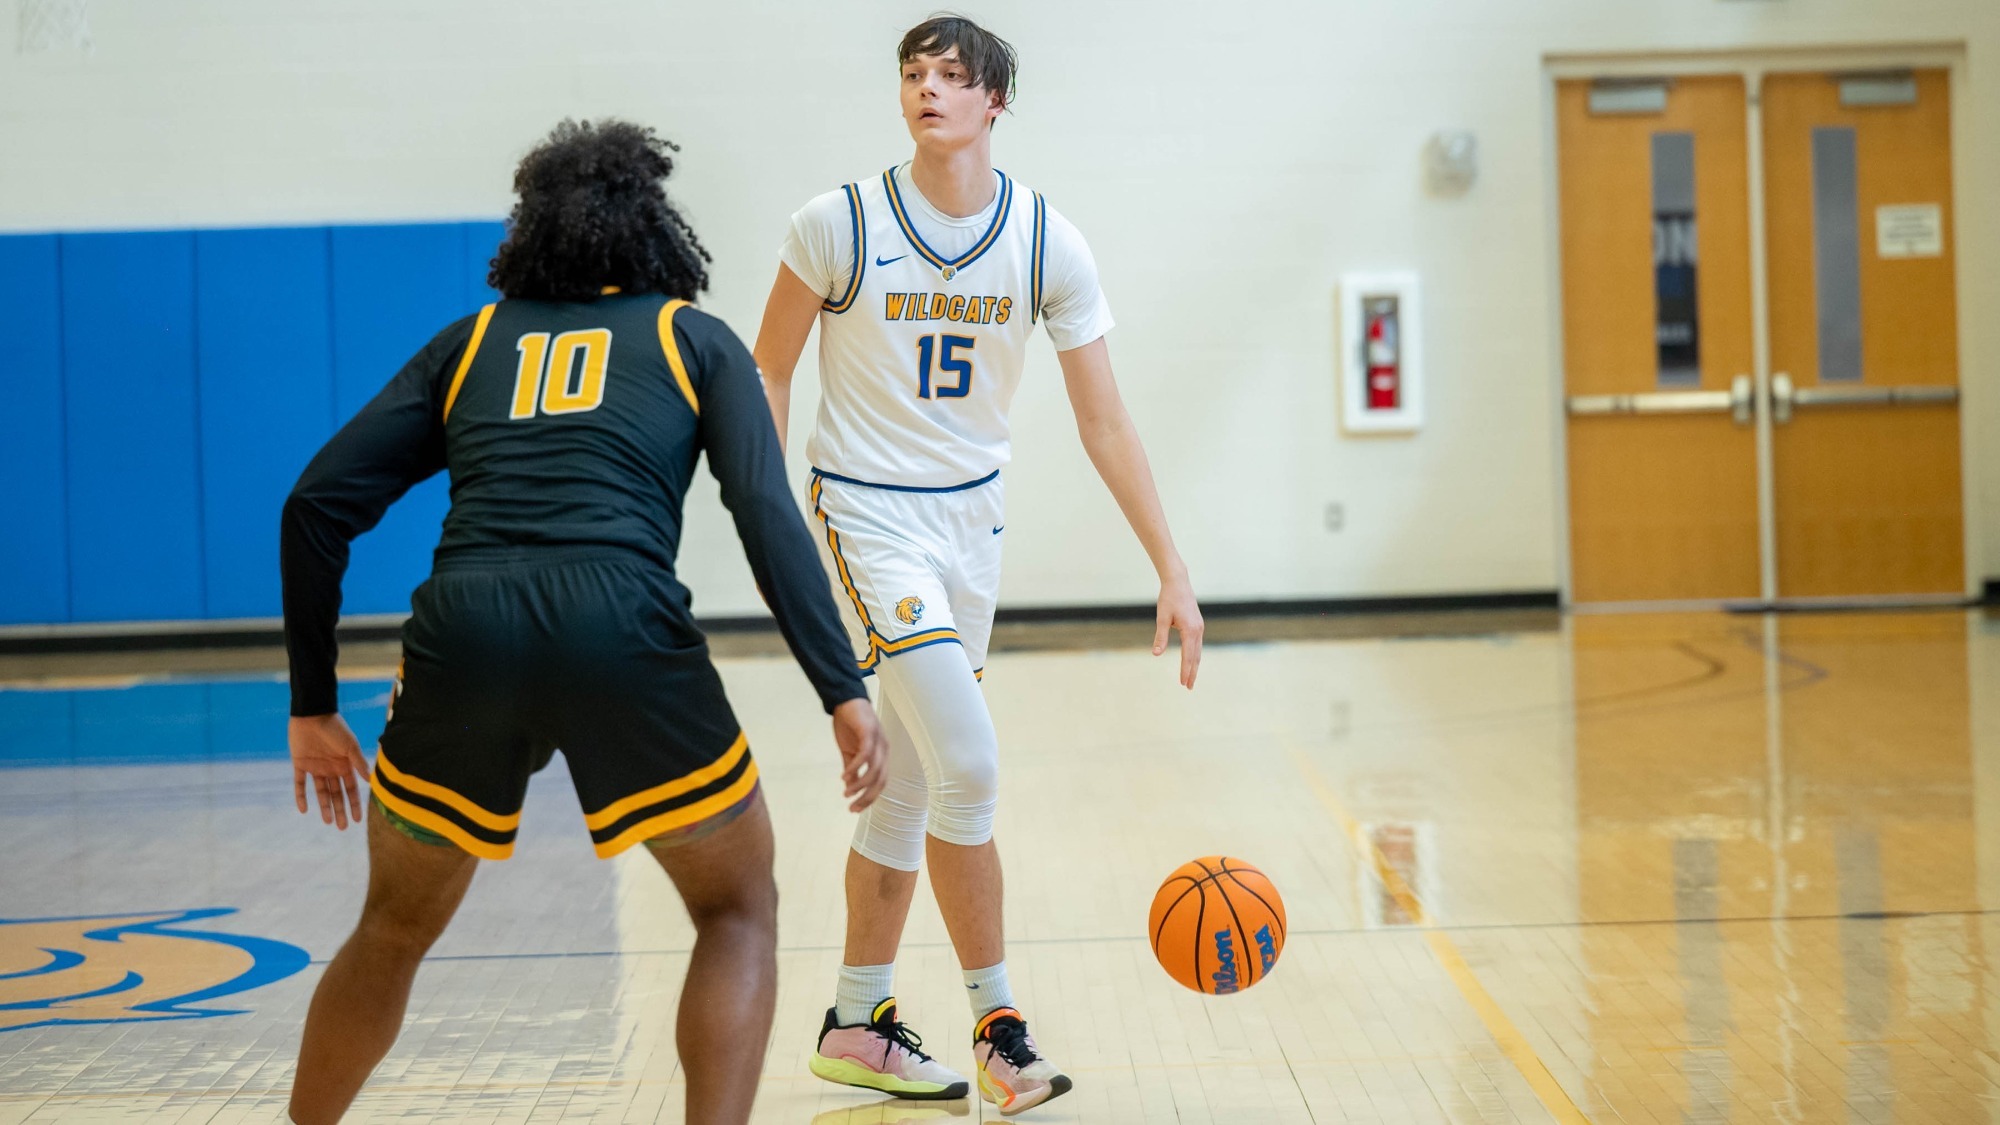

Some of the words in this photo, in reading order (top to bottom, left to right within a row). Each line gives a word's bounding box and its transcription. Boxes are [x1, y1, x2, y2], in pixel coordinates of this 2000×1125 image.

[885, 292, 1013, 325] WILDCATS
[509, 327, 613, 420] 10
[916, 332, 977, 400] 15
[1254, 923, 1277, 978] CAA
